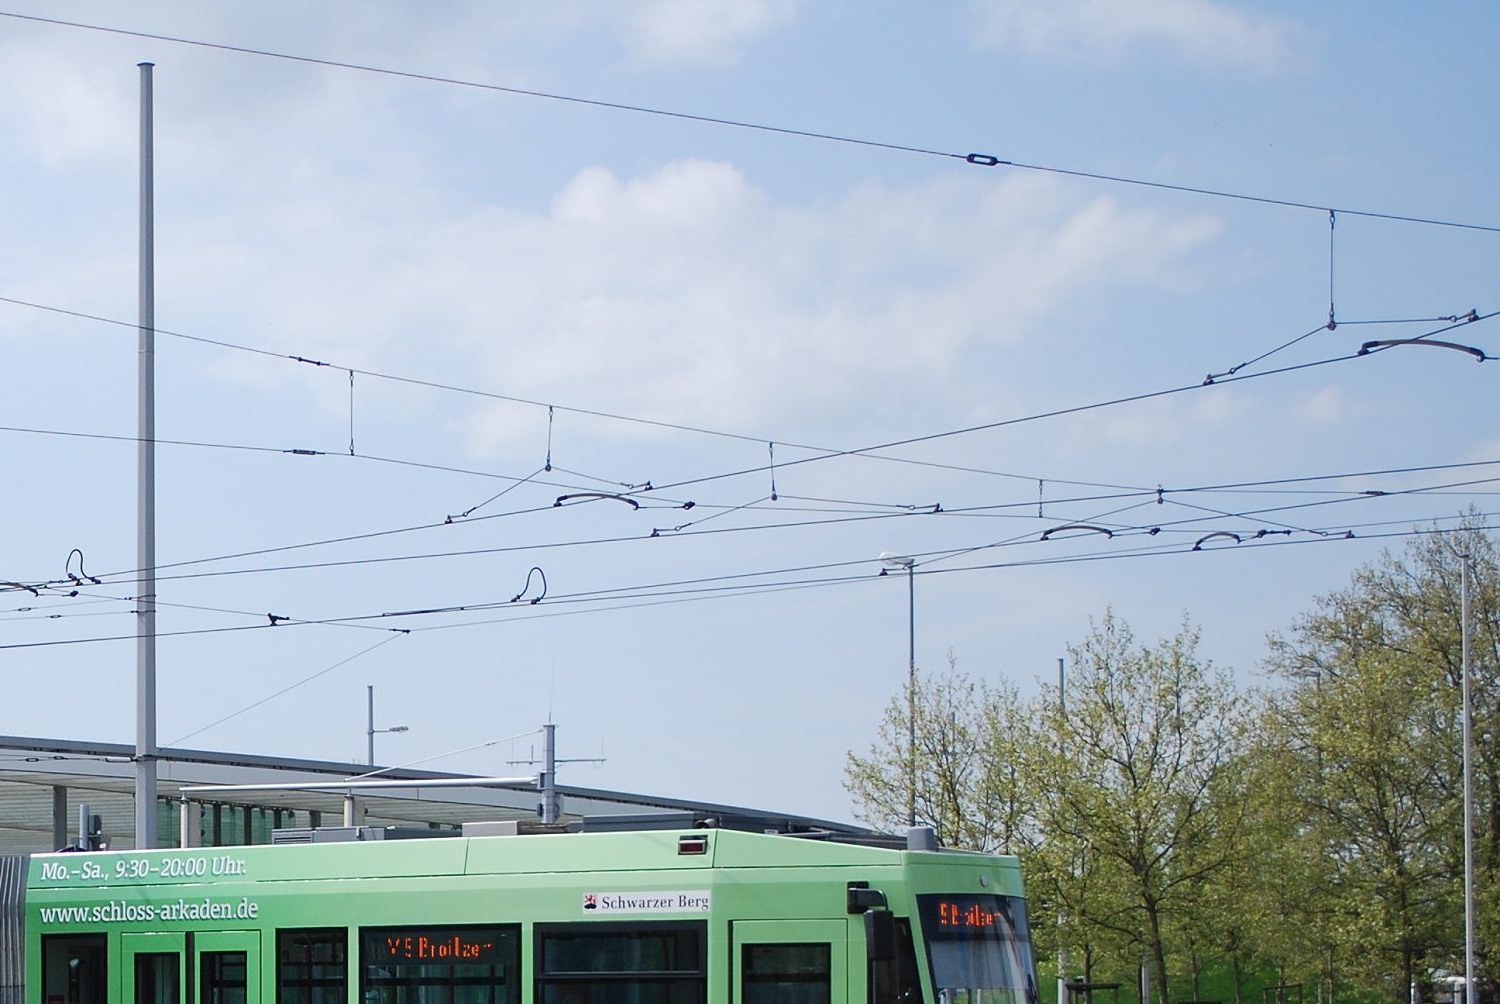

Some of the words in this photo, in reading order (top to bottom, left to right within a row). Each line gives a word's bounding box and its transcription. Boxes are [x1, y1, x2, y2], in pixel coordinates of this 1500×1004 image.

[211, 856, 247, 876] Uhr.
[40, 897, 259, 923] www.schloss-arkaden.de
[601, 896, 674, 910] Schwarzer
[678, 894, 709, 911] Berg
